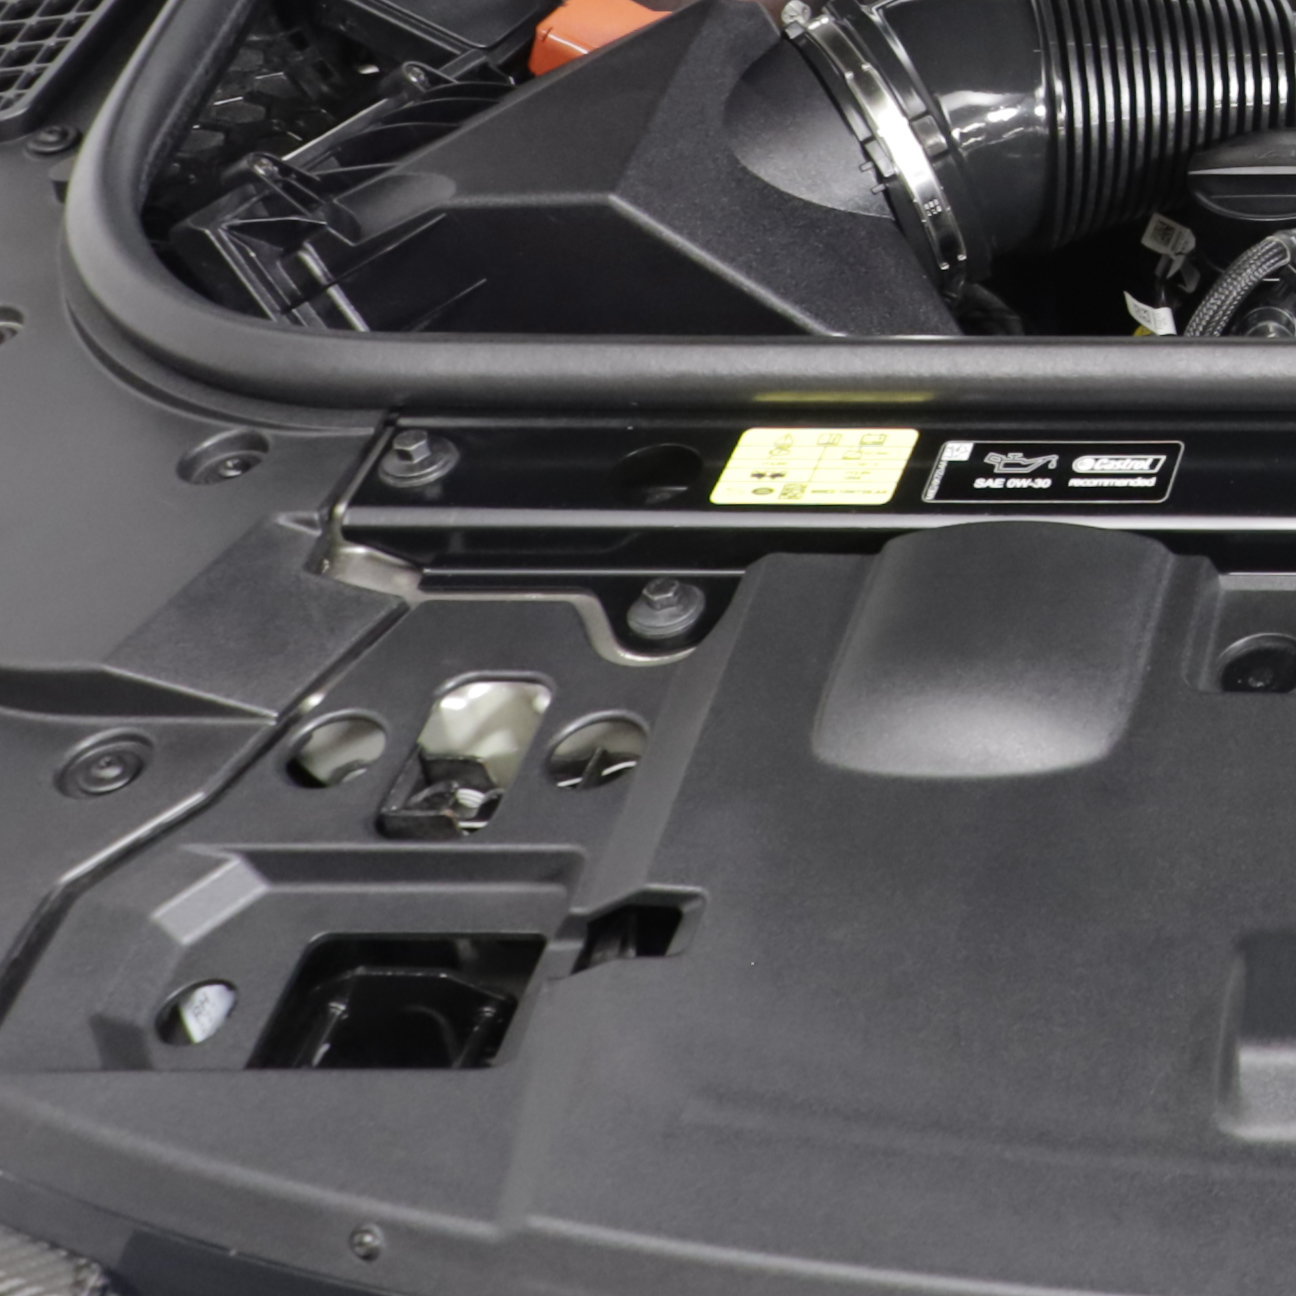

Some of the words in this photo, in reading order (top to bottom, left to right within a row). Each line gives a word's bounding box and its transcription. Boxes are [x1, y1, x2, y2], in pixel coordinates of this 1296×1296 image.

[1094, 457, 1153, 470] Castrol
[973, 478, 1004, 489] SAE
[1006, 478, 1051, 489] 0W-30
[1068, 477, 1157, 487] recommended
